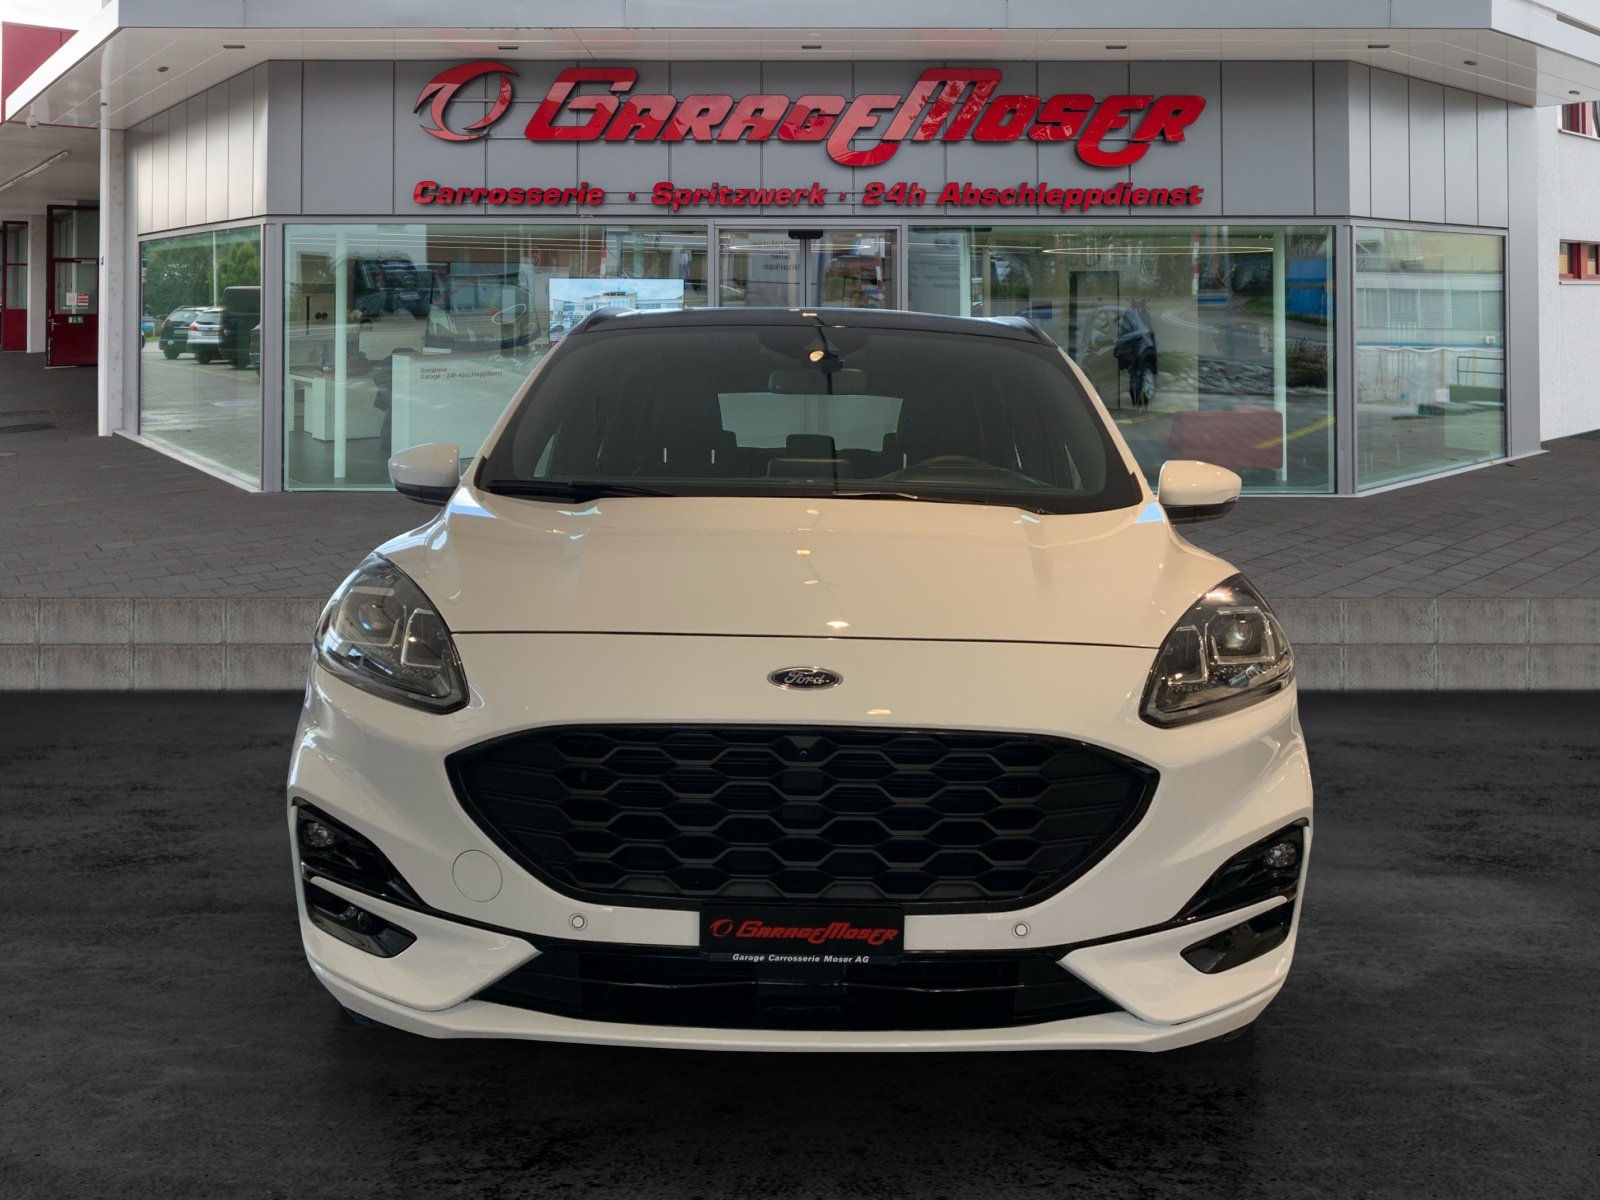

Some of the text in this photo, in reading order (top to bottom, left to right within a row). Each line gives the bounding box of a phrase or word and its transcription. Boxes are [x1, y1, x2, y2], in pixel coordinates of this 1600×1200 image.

[413, 181, 1204, 211] Carrosserie Spritzwerk 24h Abschleppdienst
[420, 373, 440, 381] Garage
[458, 369, 503, 379] Abschleppdienst
[784, 670, 826, 685] Ford
[732, 953, 870, 964] Garage Carrosserie Moser AG
